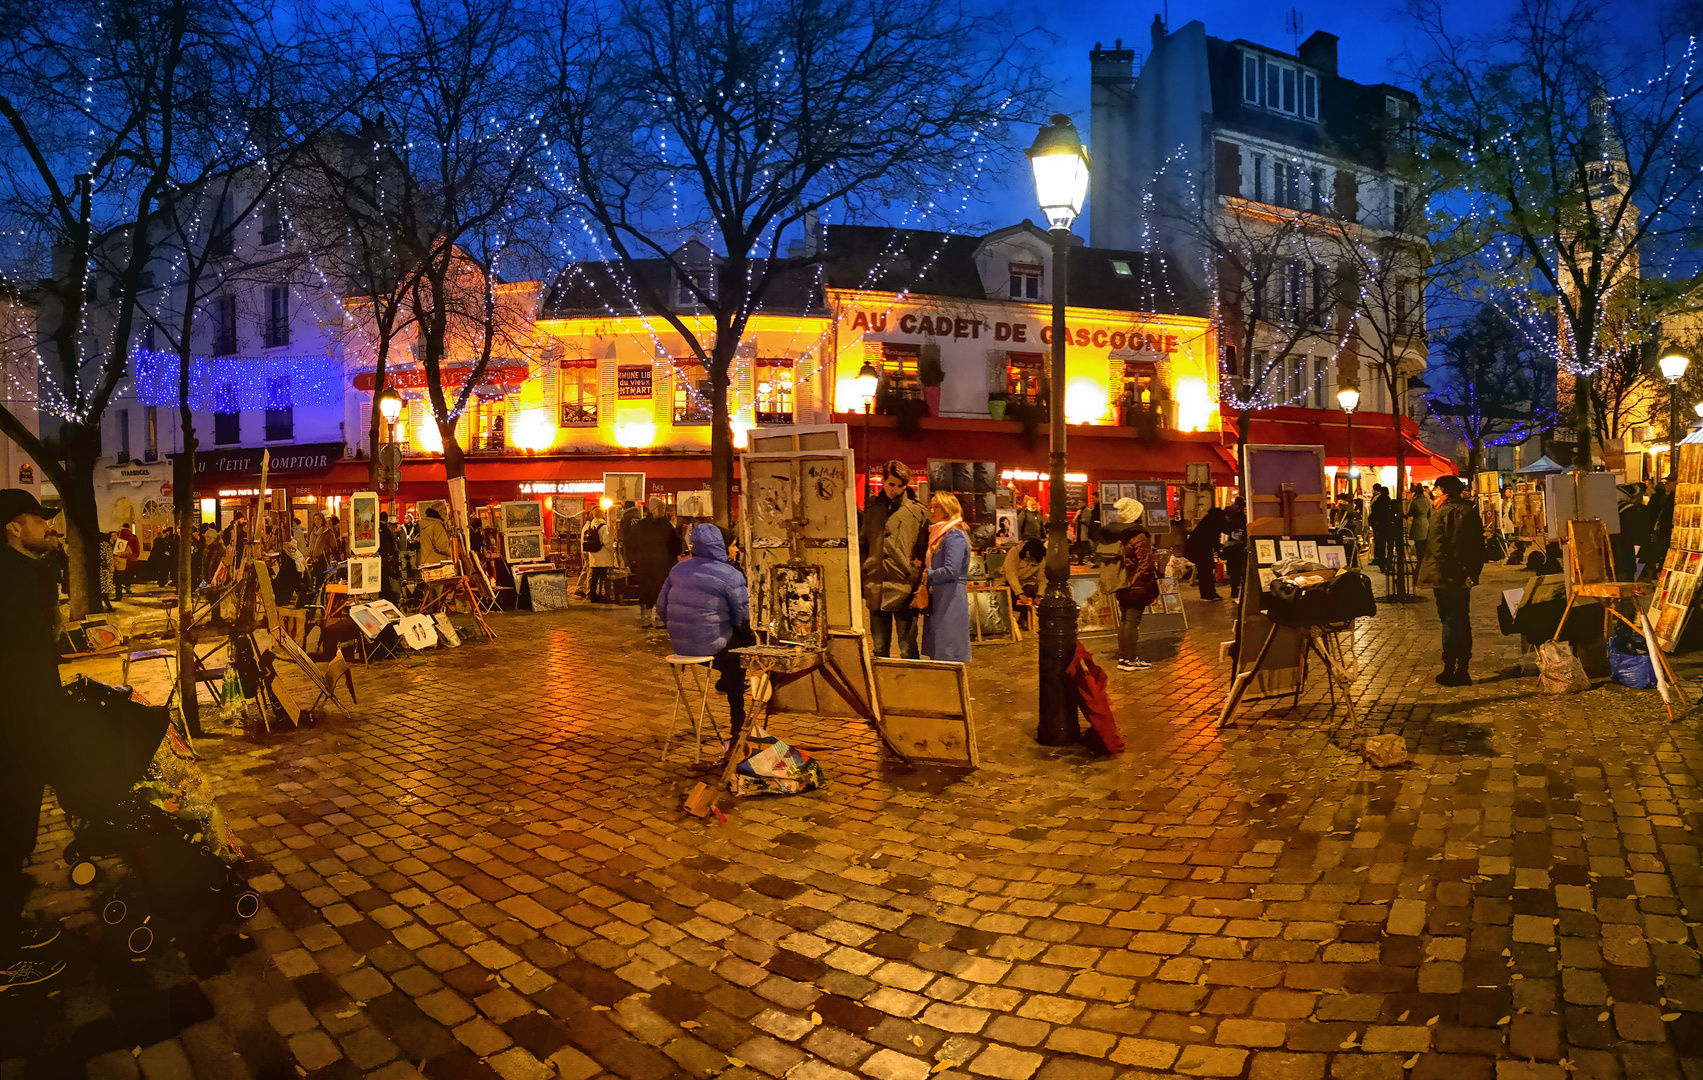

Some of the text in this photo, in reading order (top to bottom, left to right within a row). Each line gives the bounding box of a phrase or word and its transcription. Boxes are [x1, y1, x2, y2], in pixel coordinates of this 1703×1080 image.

[851, 311, 887, 333] AU
[900, 314, 983, 339] CADET
[994, 322, 1027, 343] DE
[618, 387, 652, 395] NTMART
[270, 455, 327, 470] OMPTOIR
